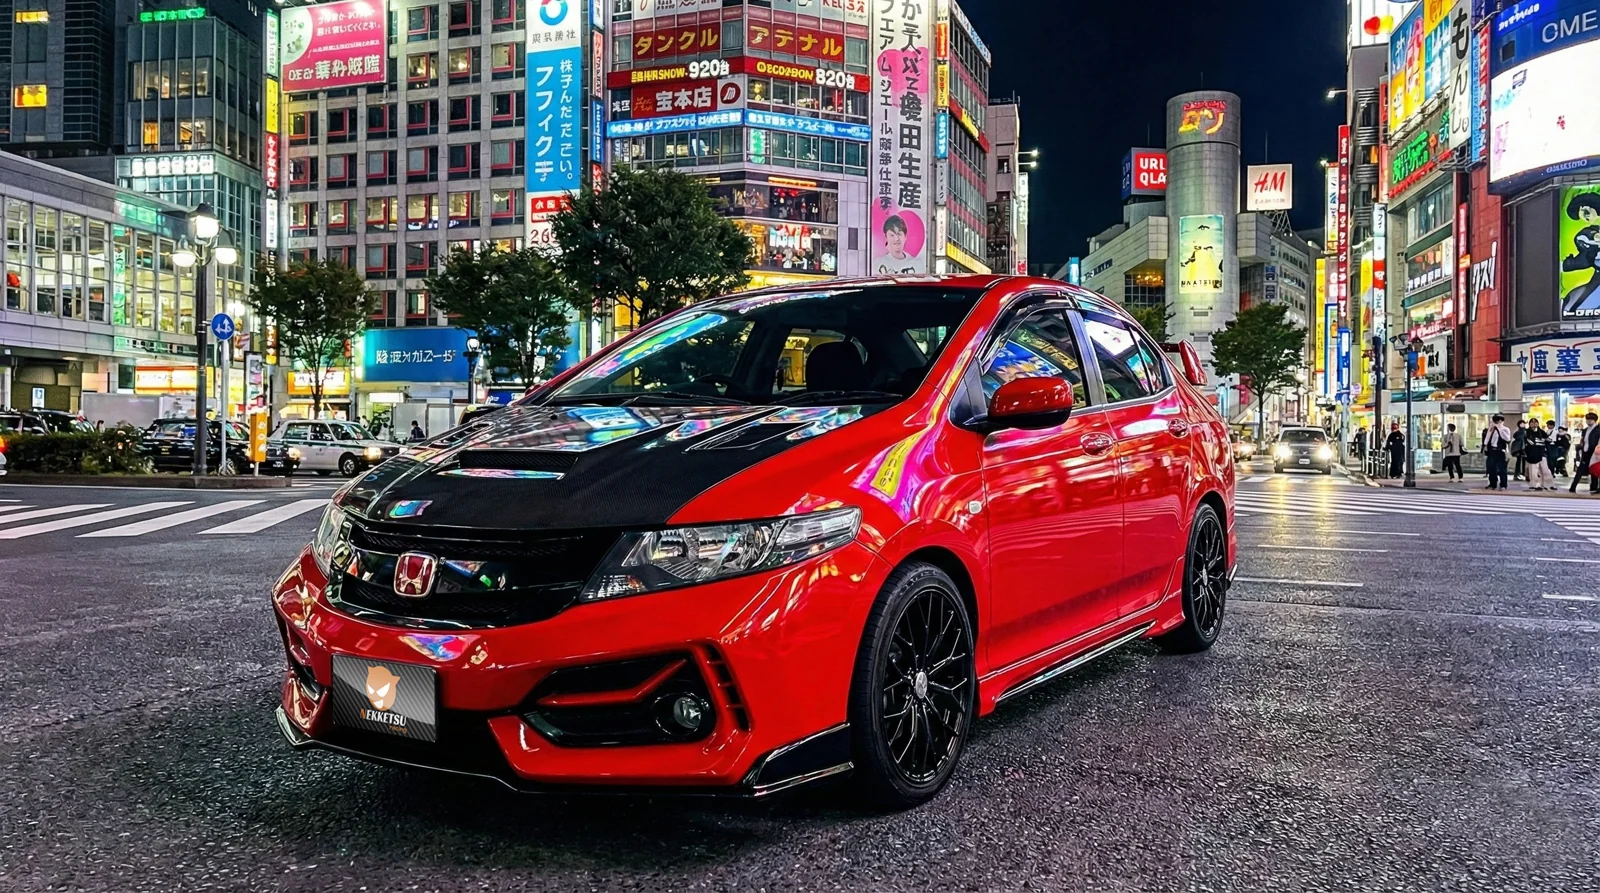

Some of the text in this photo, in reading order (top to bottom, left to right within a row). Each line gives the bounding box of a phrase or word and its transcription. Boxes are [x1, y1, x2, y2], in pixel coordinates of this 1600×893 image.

[635, 28, 720, 56] タンクル
[689, 58, 730, 78] 920台
[655, 86, 713, 112] 宝本店
[1254, 171, 1286, 193] H&M
[360, 709, 407, 726] NEKKETSU
